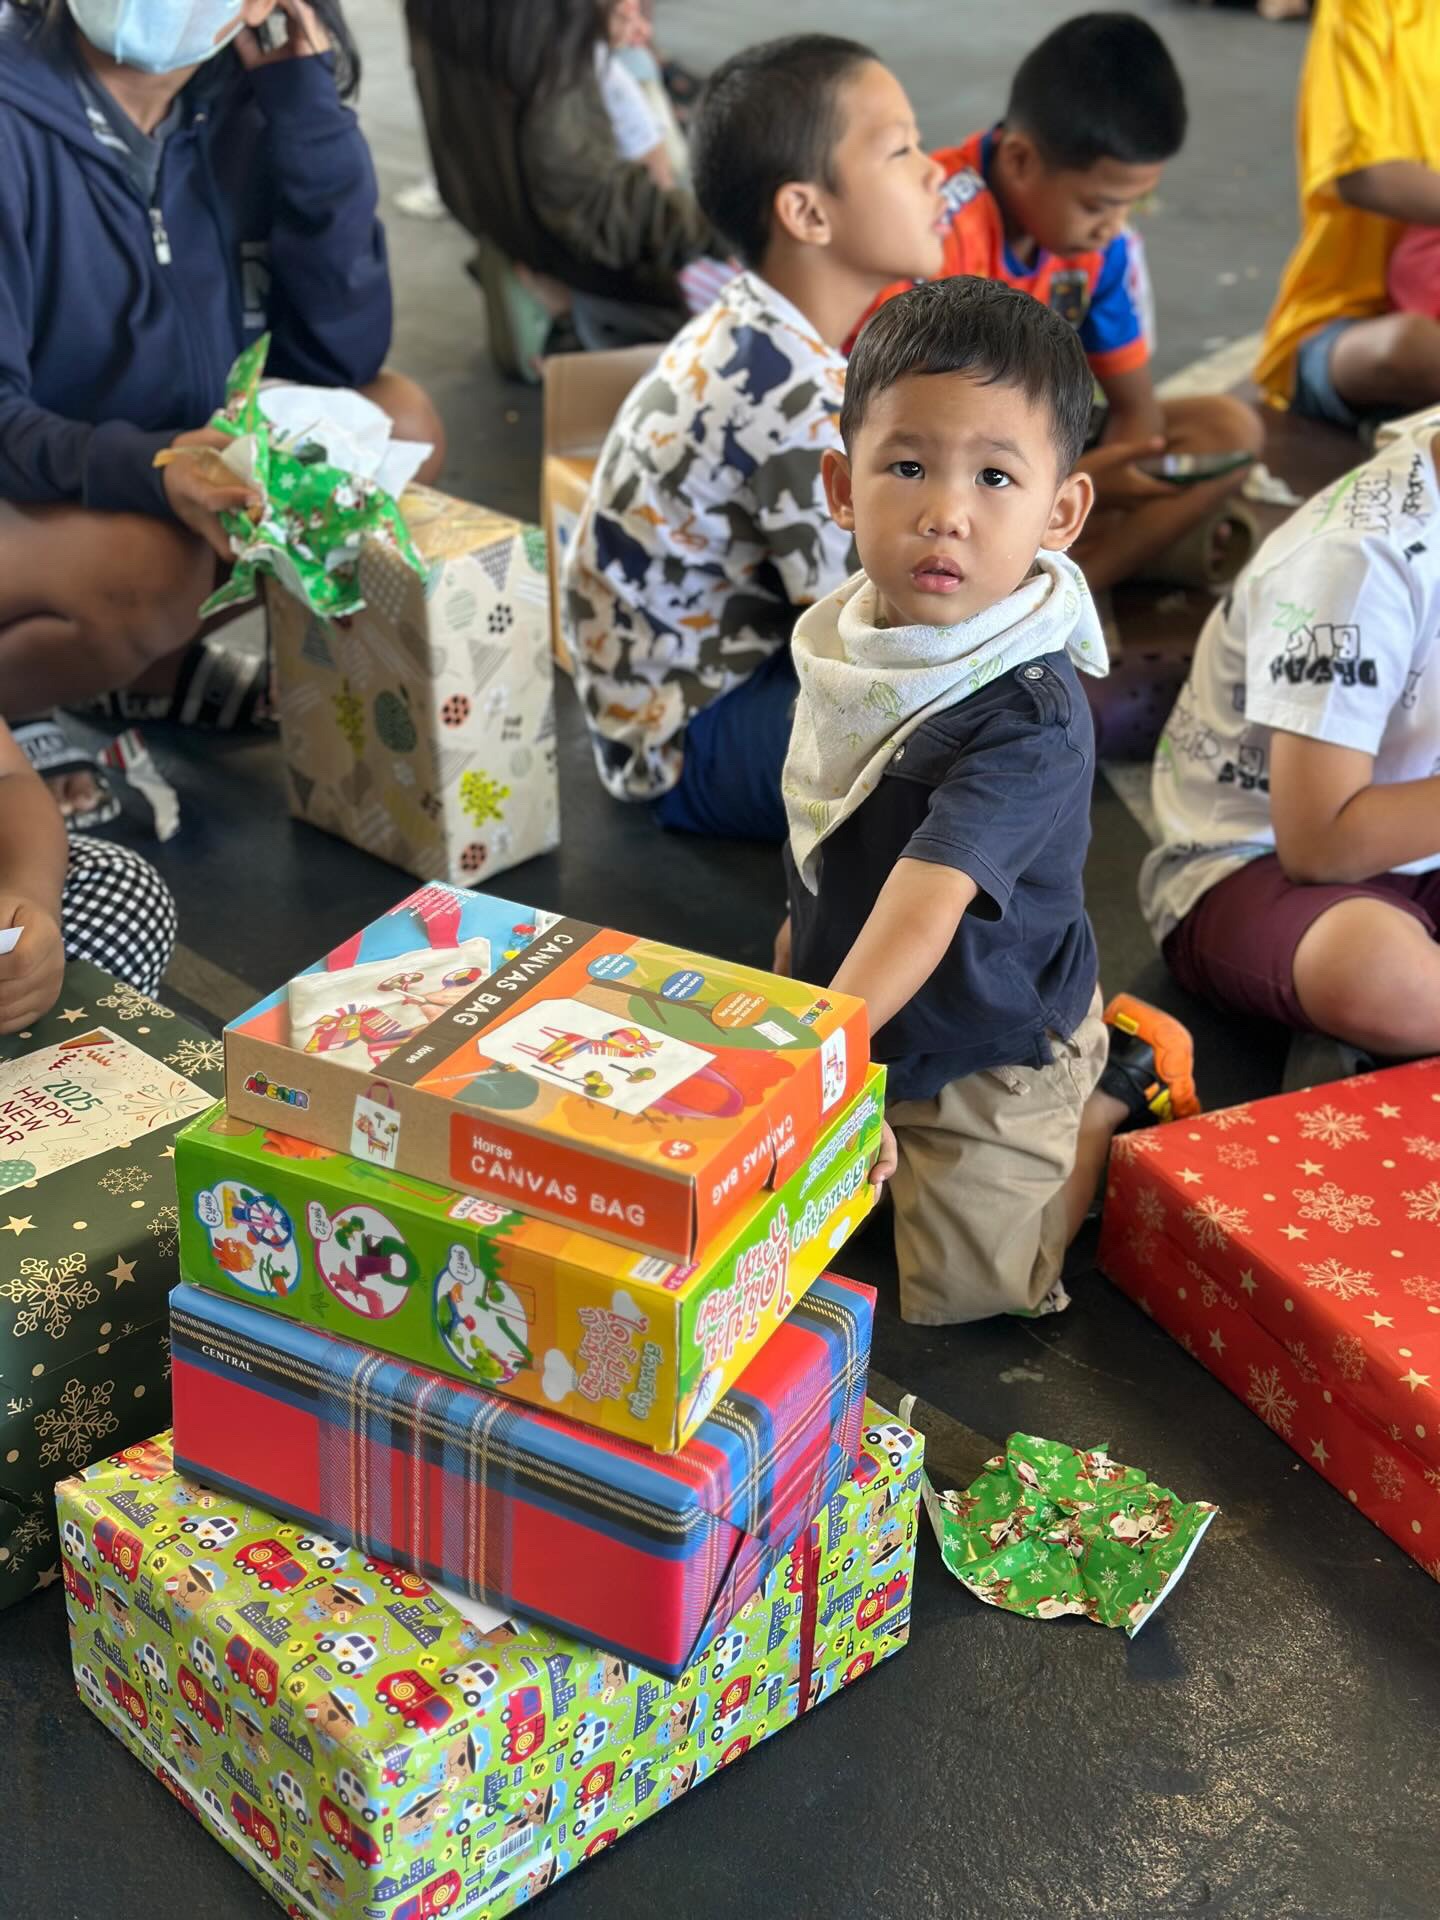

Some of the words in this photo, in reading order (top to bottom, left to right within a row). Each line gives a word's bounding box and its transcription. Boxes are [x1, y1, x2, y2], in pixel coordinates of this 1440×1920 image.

[505, 932, 574, 992] CANVAS
[452, 992, 502, 1027] BAG
[403, 1044, 435, 1064] Horse
[13, 1086, 81, 1127] HAPPY
[42, 1078, 104, 1111] 2025
[0, 1100, 50, 1132] NEW
[472, 1135, 513, 1160] Horse
[669, 1141, 691, 1157] 5+
[742, 1114, 793, 1174] CANVAS
[470, 1156, 577, 1205] CANVAS
[590, 1193, 646, 1227] BAG
[711, 1167, 739, 1206] BAG
[201, 1344, 254, 1374] CENTRAL
